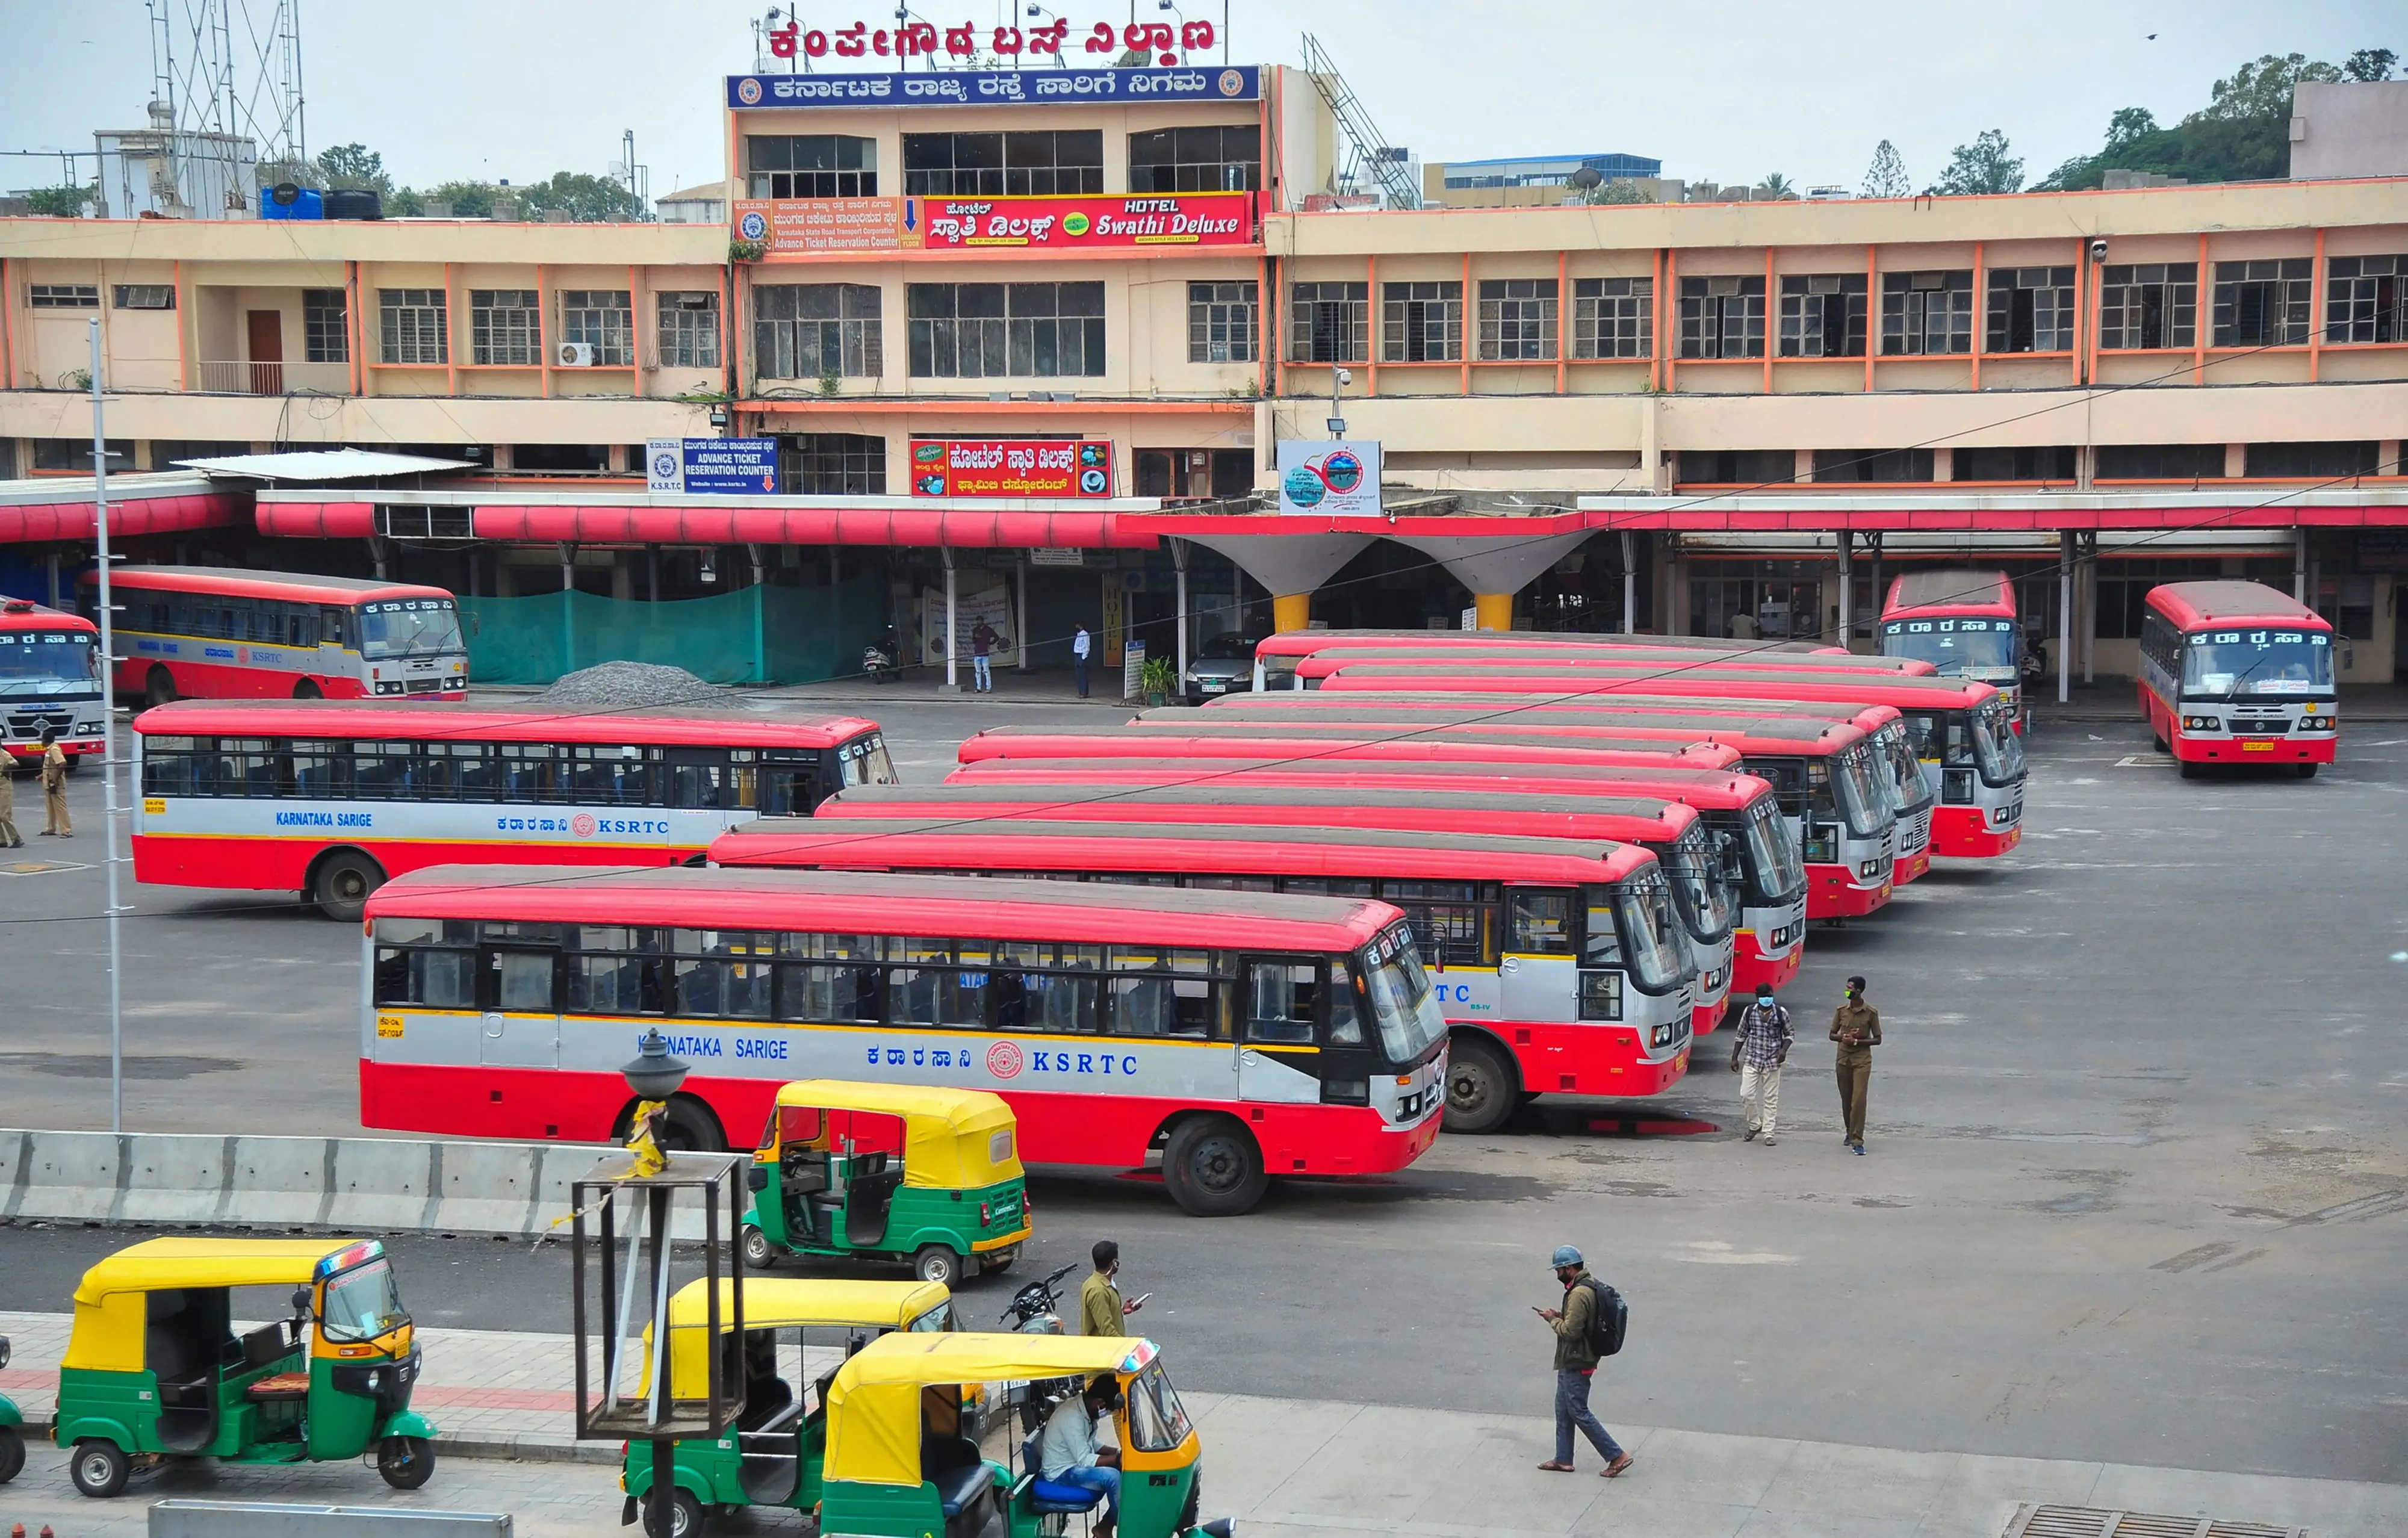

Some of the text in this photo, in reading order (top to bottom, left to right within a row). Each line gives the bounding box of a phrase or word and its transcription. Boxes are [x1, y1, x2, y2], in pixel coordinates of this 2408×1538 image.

[992, 17, 1069, 55] ಬಸ್
[774, 70, 1206, 101] ಕರ್ನಾಟಕ ರಾಜ್ಯ ರಸ್ತೆ ಸಾರಿಗೆ ನಿಗಮ
[946, 202, 992, 214] ಹೋಟೆಲ್
[1125, 199, 1179, 212] HOTEL
[930, 215, 1055, 243] ಸ್ವಾತಿ ಡಿಲಕ್ಸ್
[1096, 214, 1239, 235] Swathi Deluxe
[836, 228, 862, 237] Transport
[775, 238, 803, 249] Advance
[805, 238, 827, 248] Ticket
[828, 237, 869, 247] Reservation
[871, 237, 898, 247] Counter
[698, 453, 762, 464] ADVANCE TICKET
[950, 444, 1074, 477] ಹೋಟೆಲ್ ಸ್ವಾತಿ ಡಿಲಕ್ಸ್
[685, 465, 774, 476] RESERVATION COUNTER
[252, 651, 282, 663] KSRTC
[276, 812, 371, 826] KARNATAKA SARIGE
[638, 1035, 787, 1059] KNATAKA SARIGE
